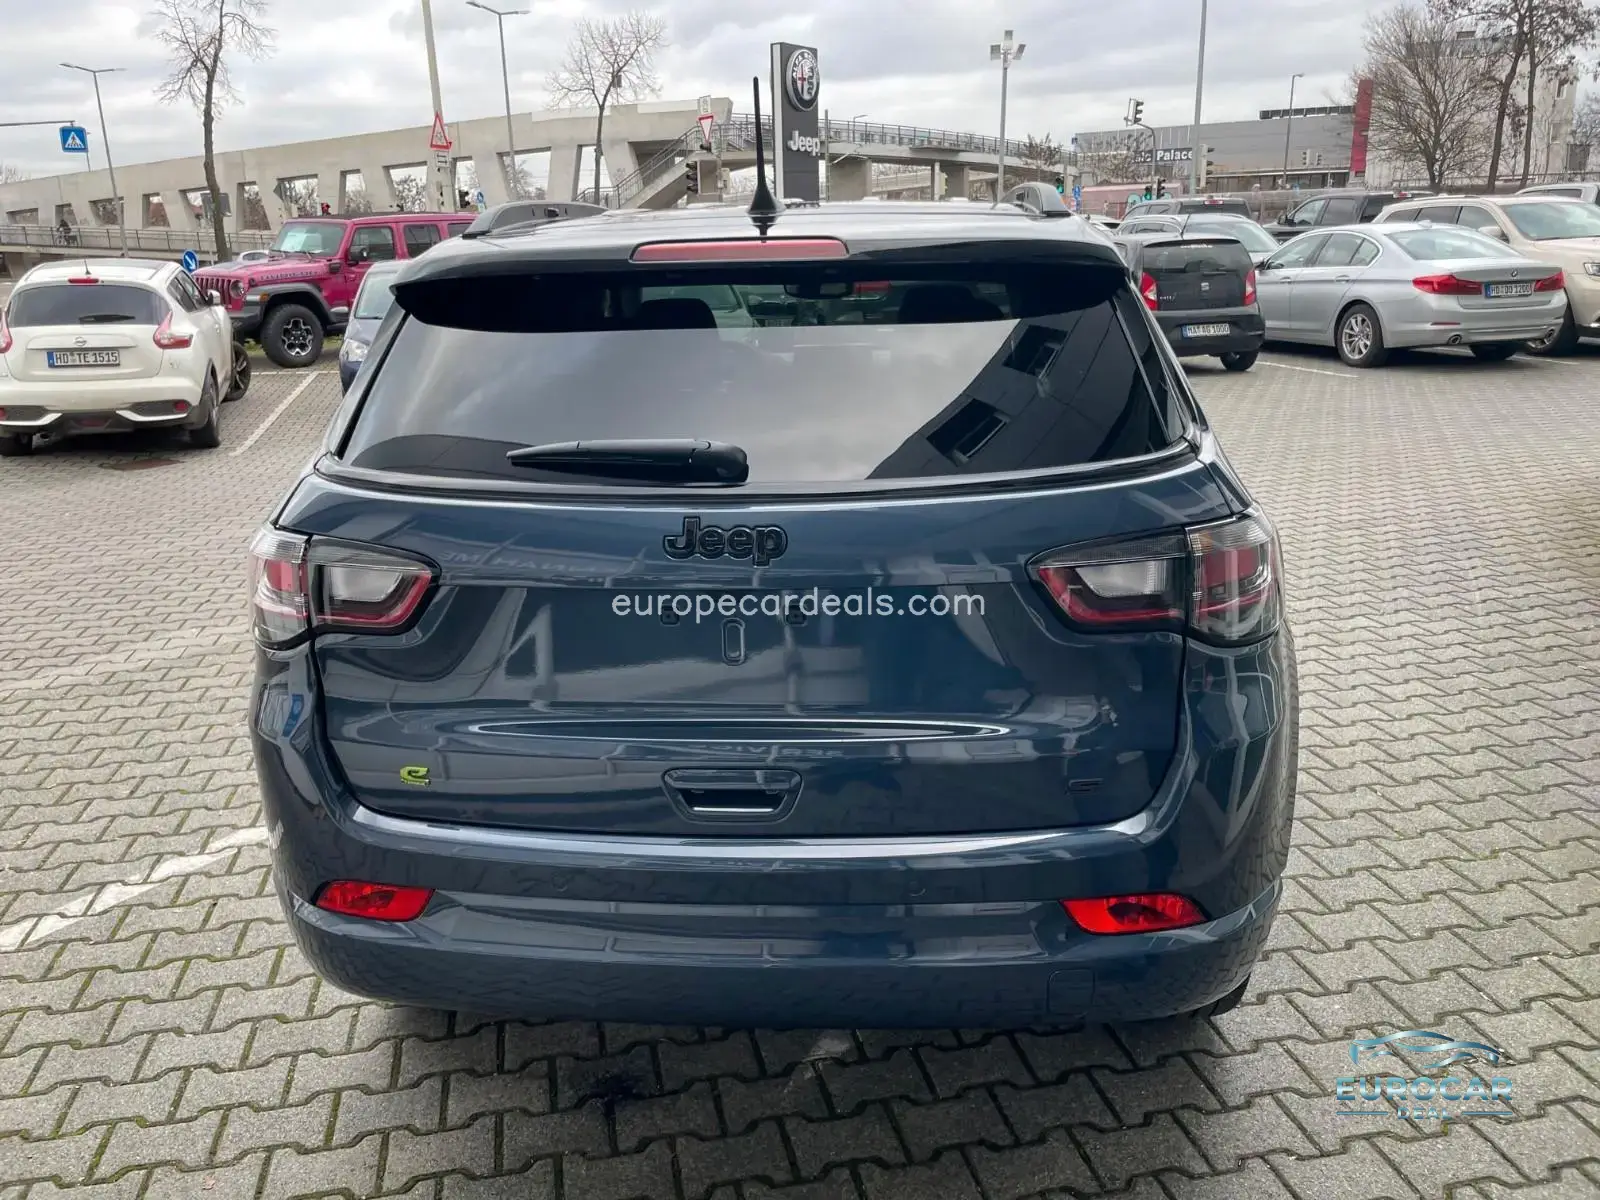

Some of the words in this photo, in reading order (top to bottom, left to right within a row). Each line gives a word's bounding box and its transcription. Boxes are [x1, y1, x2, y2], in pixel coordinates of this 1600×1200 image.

[787, 130, 820, 156] Jeep
[1156, 149, 1193, 161] Palace
[55, 352, 69, 364] HD
[77, 352, 90, 364] TE
[93, 351, 118, 363] 1515
[662, 515, 788, 568] Jeep
